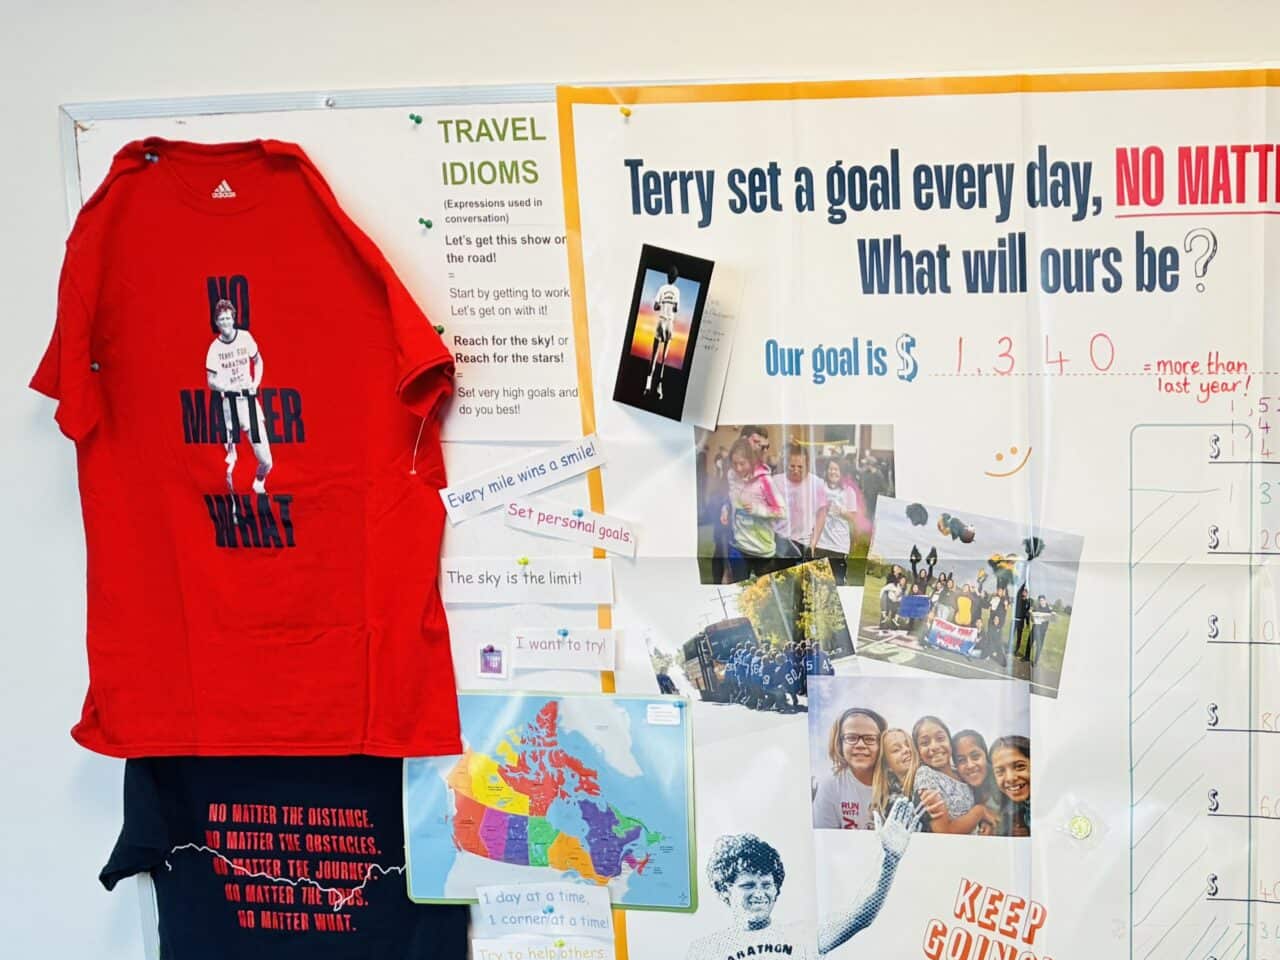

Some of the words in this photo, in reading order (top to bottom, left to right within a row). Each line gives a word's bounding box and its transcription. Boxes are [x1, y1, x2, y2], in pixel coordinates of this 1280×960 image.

[437, 116, 547, 143] TRAVEL
[441, 160, 539, 186] IDIOMS
[623, 158, 716, 229] Terry
[726, 161, 783, 215] set
[794, 166, 815, 214] a
[825, 148, 901, 225] goal
[912, 160, 1015, 224] every
[1026, 144, 1102, 222] day,
[1114, 145, 1165, 208] NO
[443, 199, 505, 211] (Expressions
[507, 198, 531, 208] used
[533, 198, 543, 207] in
[445, 213, 510, 224] conversation)
[857, 234, 951, 296] What
[962, 231, 1028, 294] will
[1039, 243, 1122, 294] ours
[206, 274, 250, 334] NO
[453, 335, 486, 347] Reach
[488, 335, 504, 346] for
[506, 335, 528, 346] the
[530, 334, 555, 348] sky!
[558, 336, 568, 345] or
[455, 352, 489, 364] Reach
[491, 352, 506, 363] for
[508, 352, 529, 363] the
[531, 352, 564, 364] stars!
[764, 338, 805, 377] Our
[811, 336, 860, 385] goal
[866, 339, 888, 377] is
[1156, 359, 1200, 375] more
[1207, 351, 1248, 373] than
[1157, 377, 1191, 394] last
[1197, 375, 1251, 403] year!
[179, 387, 305, 444] MATTER
[447, 486, 485, 509] Every
[488, 475, 515, 494] mile
[517, 462, 547, 483] wins
[549, 460, 558, 471] a
[560, 442, 596, 467] smile!
[203, 493, 297, 549] WHAT
[508, 503, 534, 520] Set
[536, 511, 596, 534] personal
[598, 525, 633, 543] goals.
[208, 803, 227, 823] NO
[232, 804, 277, 825] MATTER
[282, 806, 304, 826] THE
[308, 807, 374, 828] DISTANCE.
[238, 910, 255, 928] NO
[261, 911, 308, 931] MATTER
[314, 913, 357, 932] WHAT.
[953, 876, 1048, 946] KEEP
